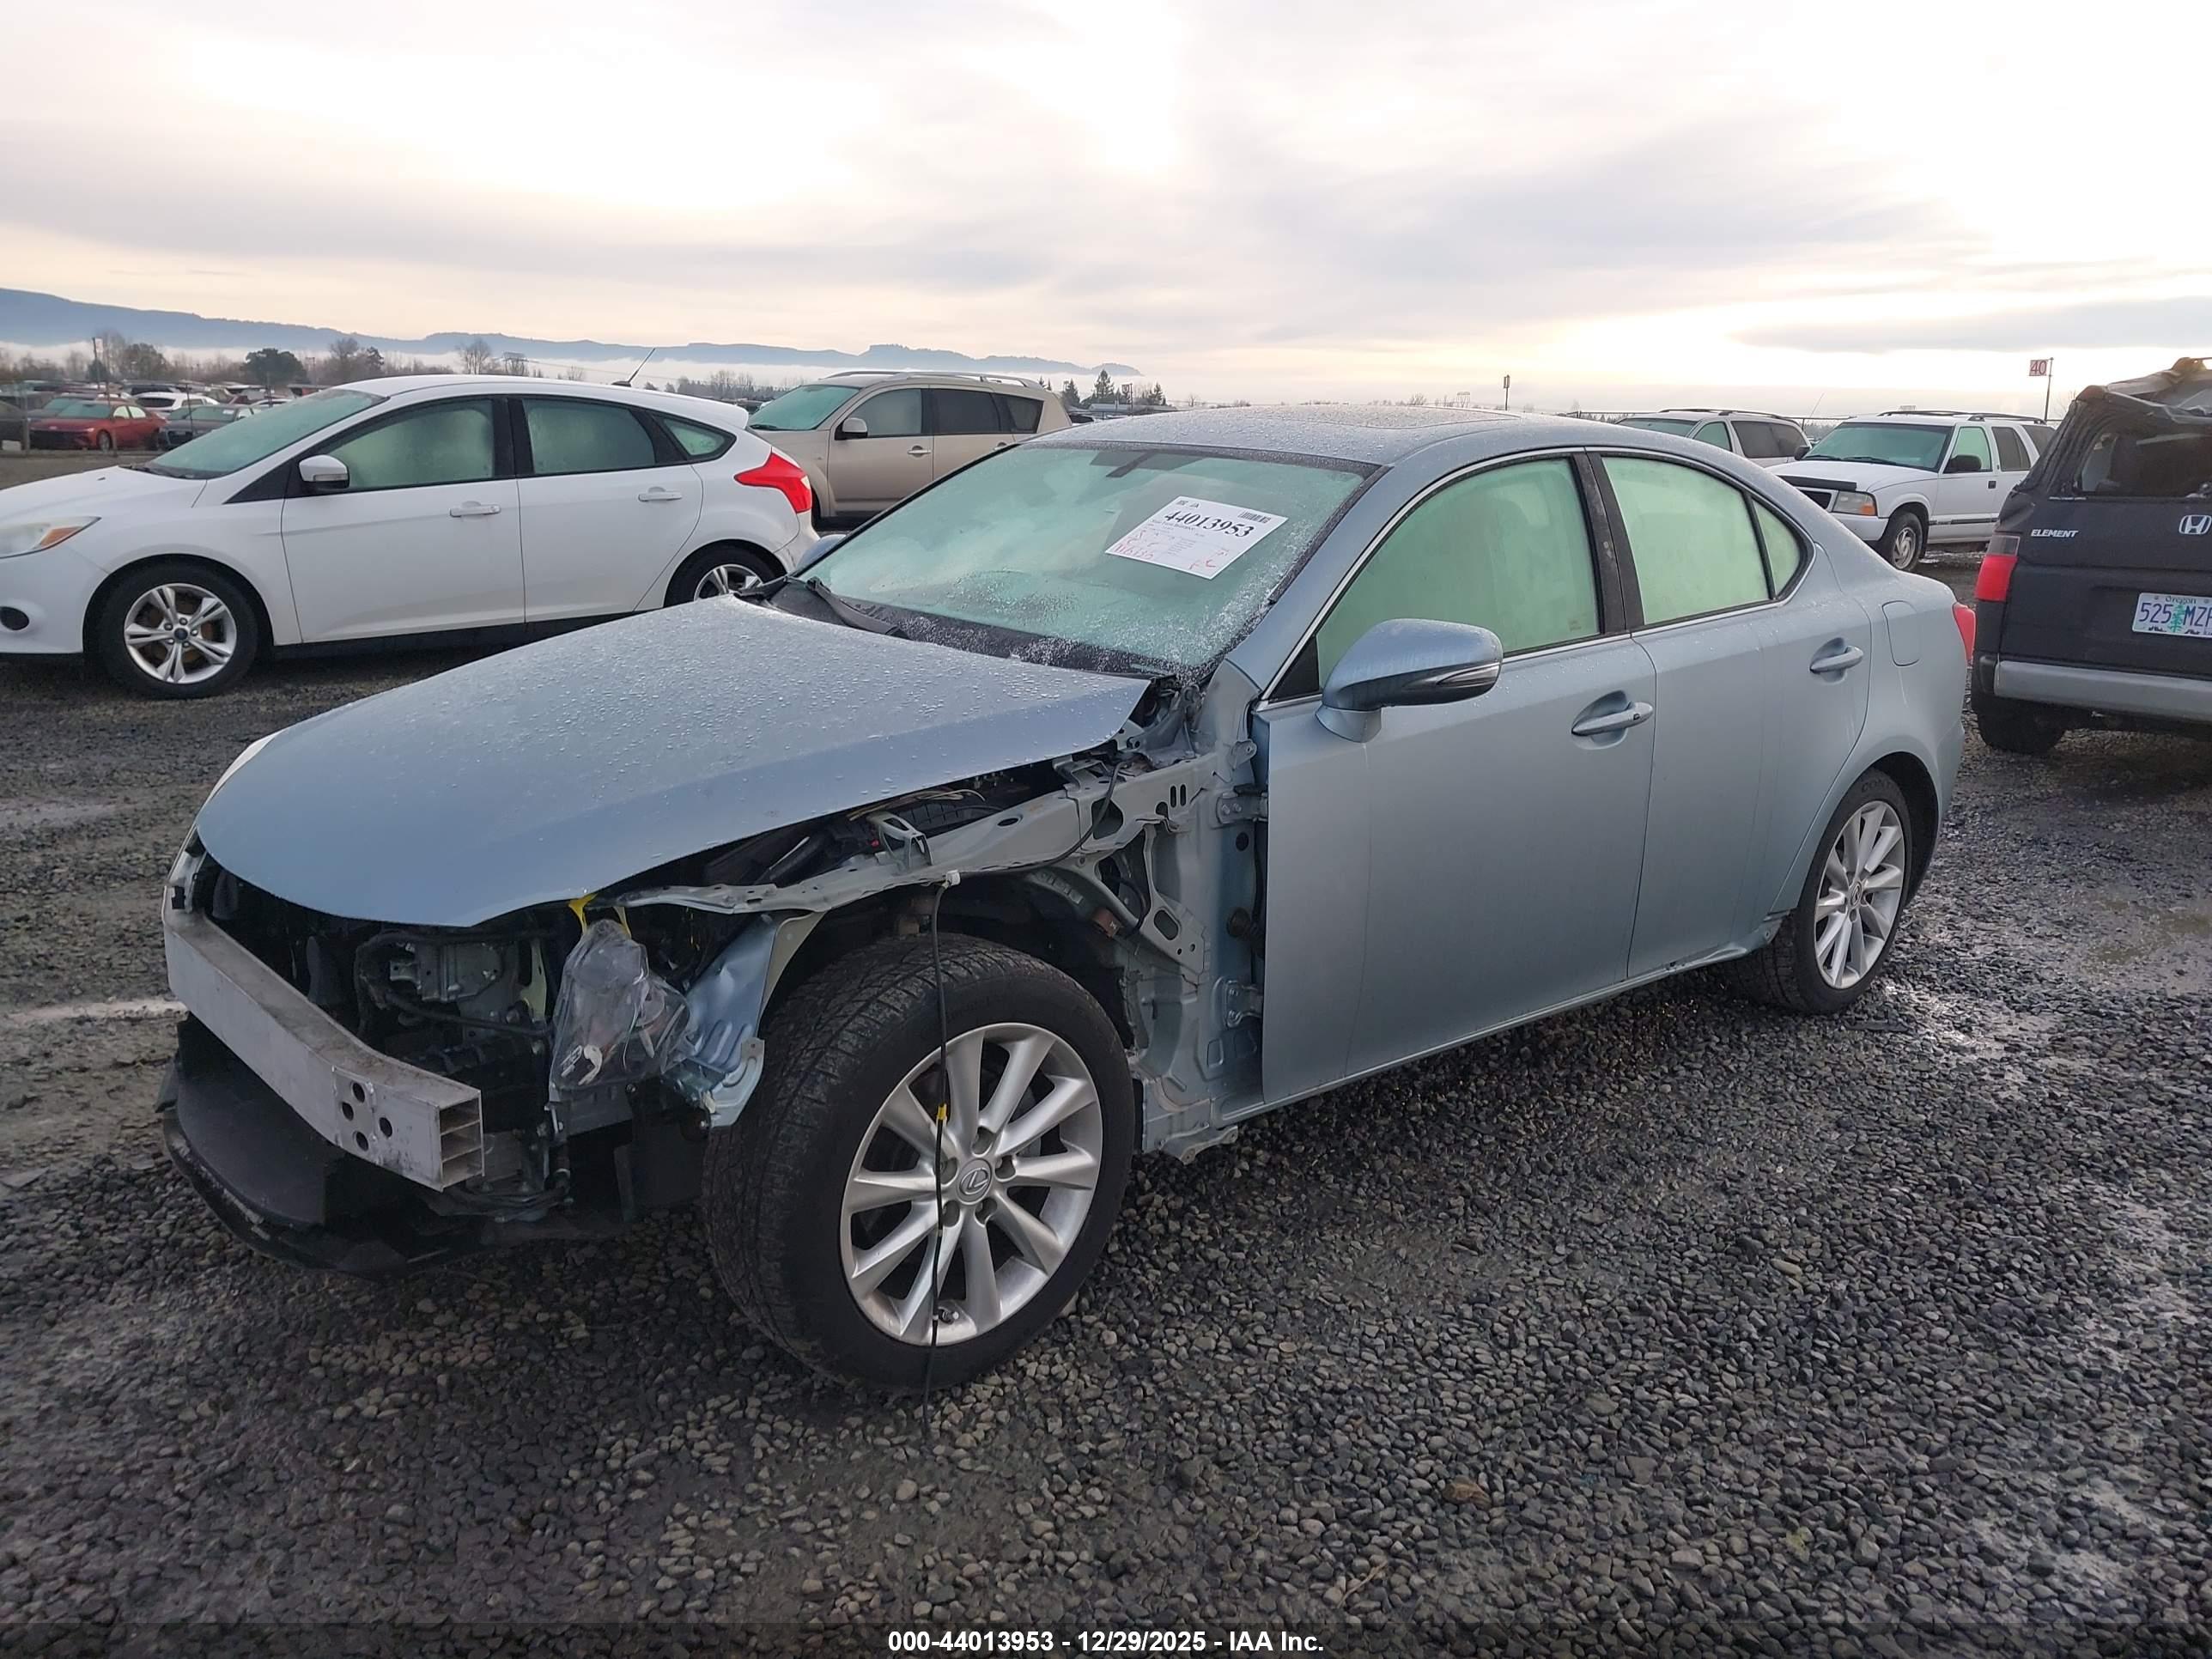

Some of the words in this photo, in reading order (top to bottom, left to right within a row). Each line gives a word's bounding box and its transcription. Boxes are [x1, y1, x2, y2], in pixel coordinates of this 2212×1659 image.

[2031, 360, 2046, 375] 40
[1164, 511, 1255, 538] 44013953
[2031, 528, 2079, 538] ELEMENT
[2165, 595, 2197, 605] Oregon
[2138, 602, 2173, 623] 525
